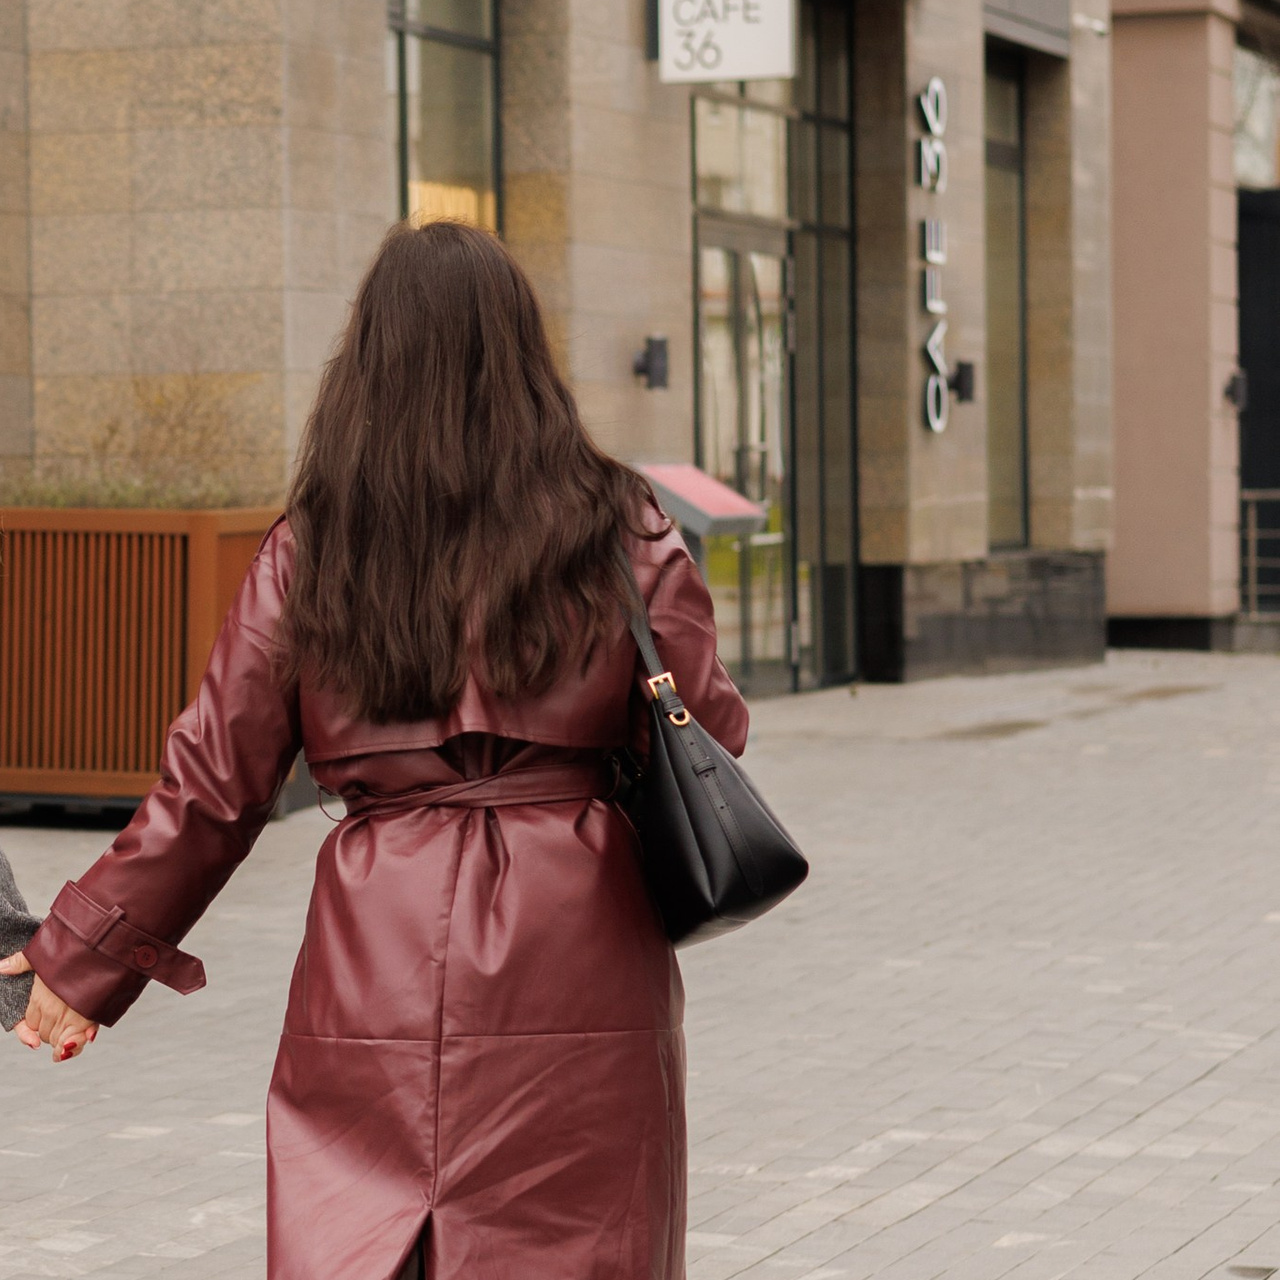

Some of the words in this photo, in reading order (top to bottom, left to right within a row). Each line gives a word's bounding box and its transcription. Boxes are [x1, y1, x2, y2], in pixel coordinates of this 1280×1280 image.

[673, 28, 722, 71] 36
[920, 76, 948, 193] 36
[925, 220, 949, 433] CAFE
